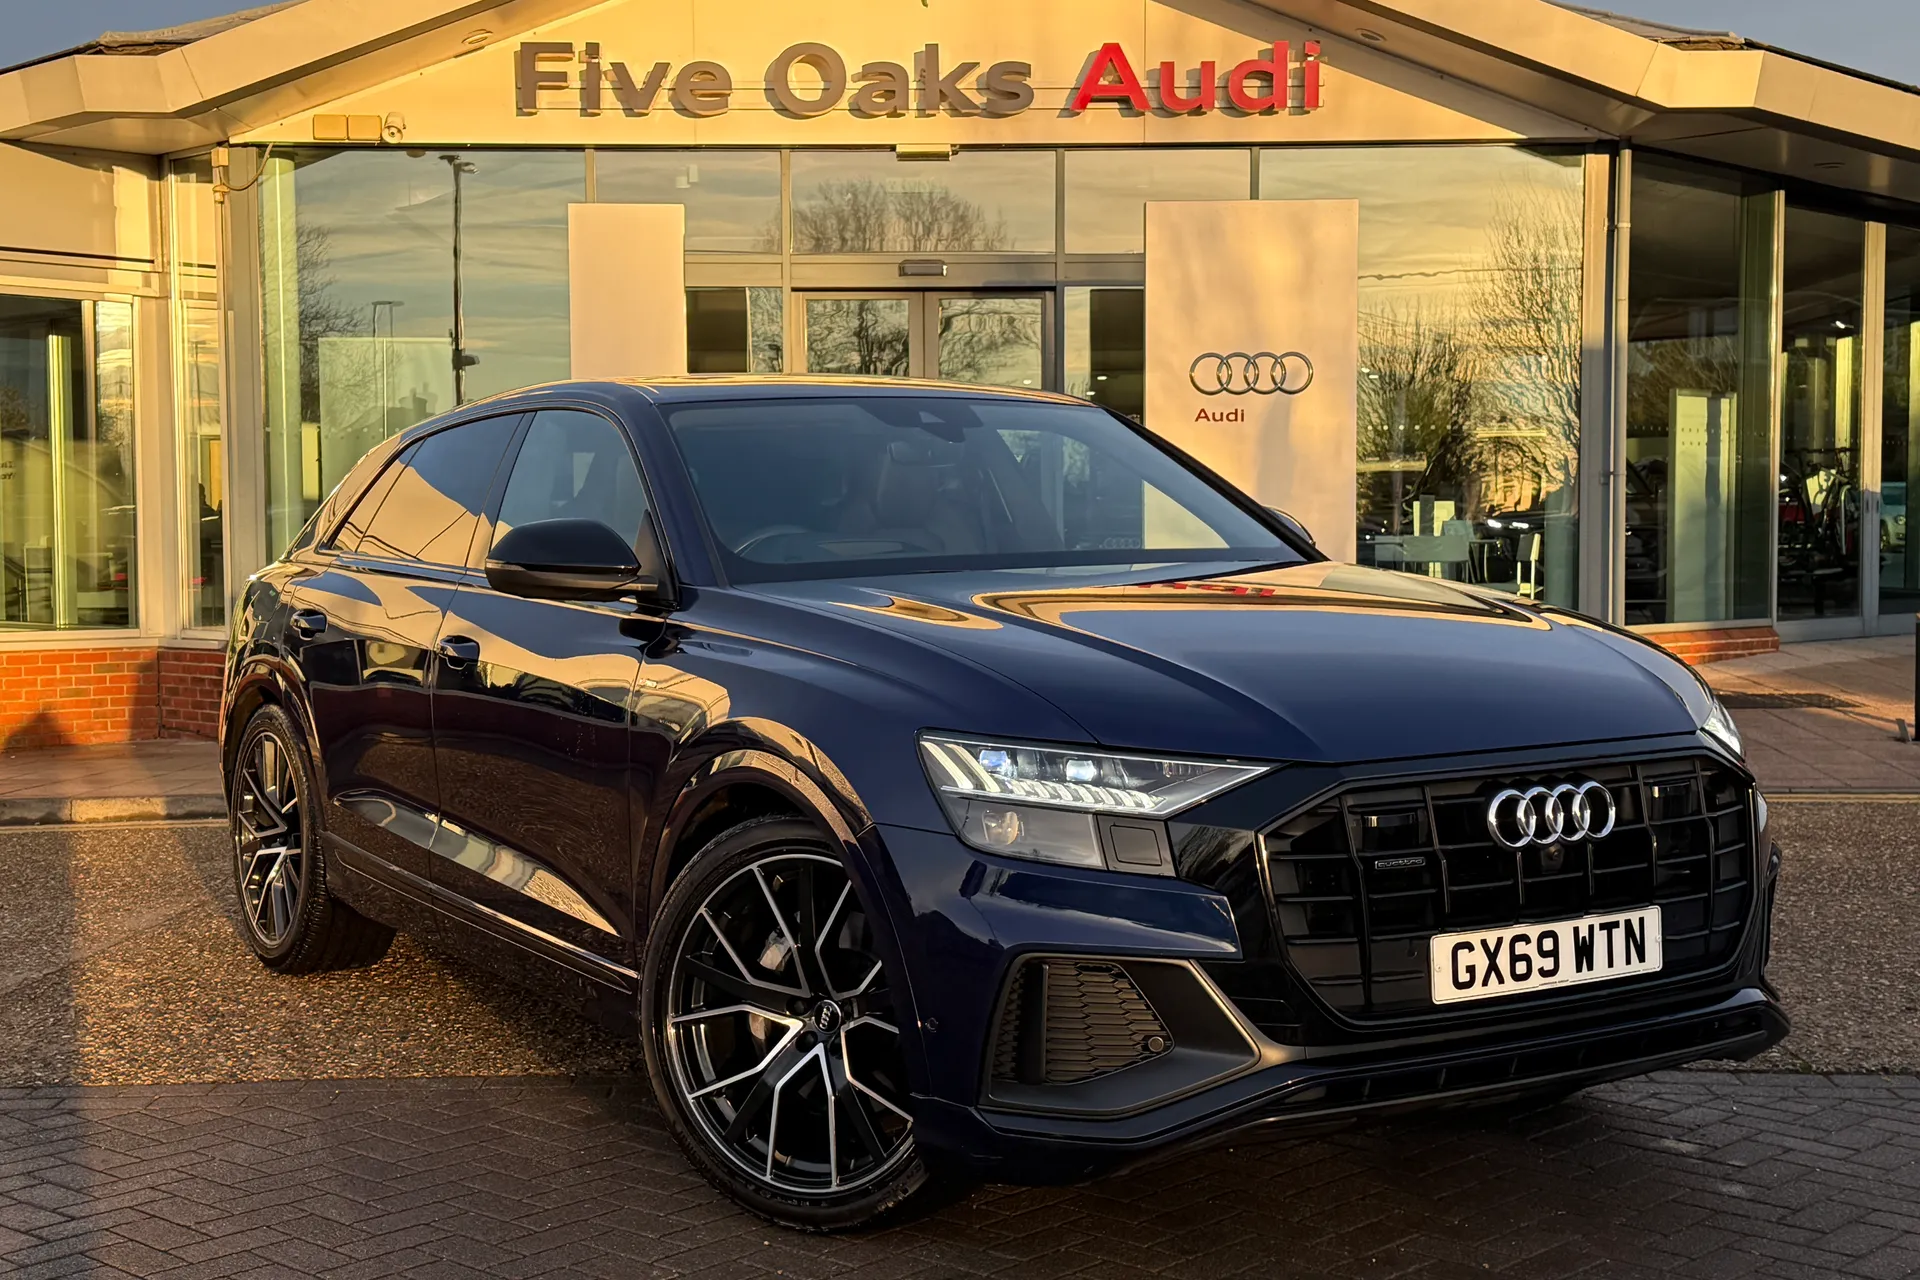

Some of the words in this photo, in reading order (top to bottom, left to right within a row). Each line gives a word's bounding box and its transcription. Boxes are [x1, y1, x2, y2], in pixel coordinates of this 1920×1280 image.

[517, 41, 733, 116] Five
[769, 42, 1034, 117] Oaks
[1068, 40, 1322, 113] Audi
[1194, 408, 1245, 422] Audi
[1451, 929, 1560, 991] GX69
[1573, 916, 1646, 974] WTN
